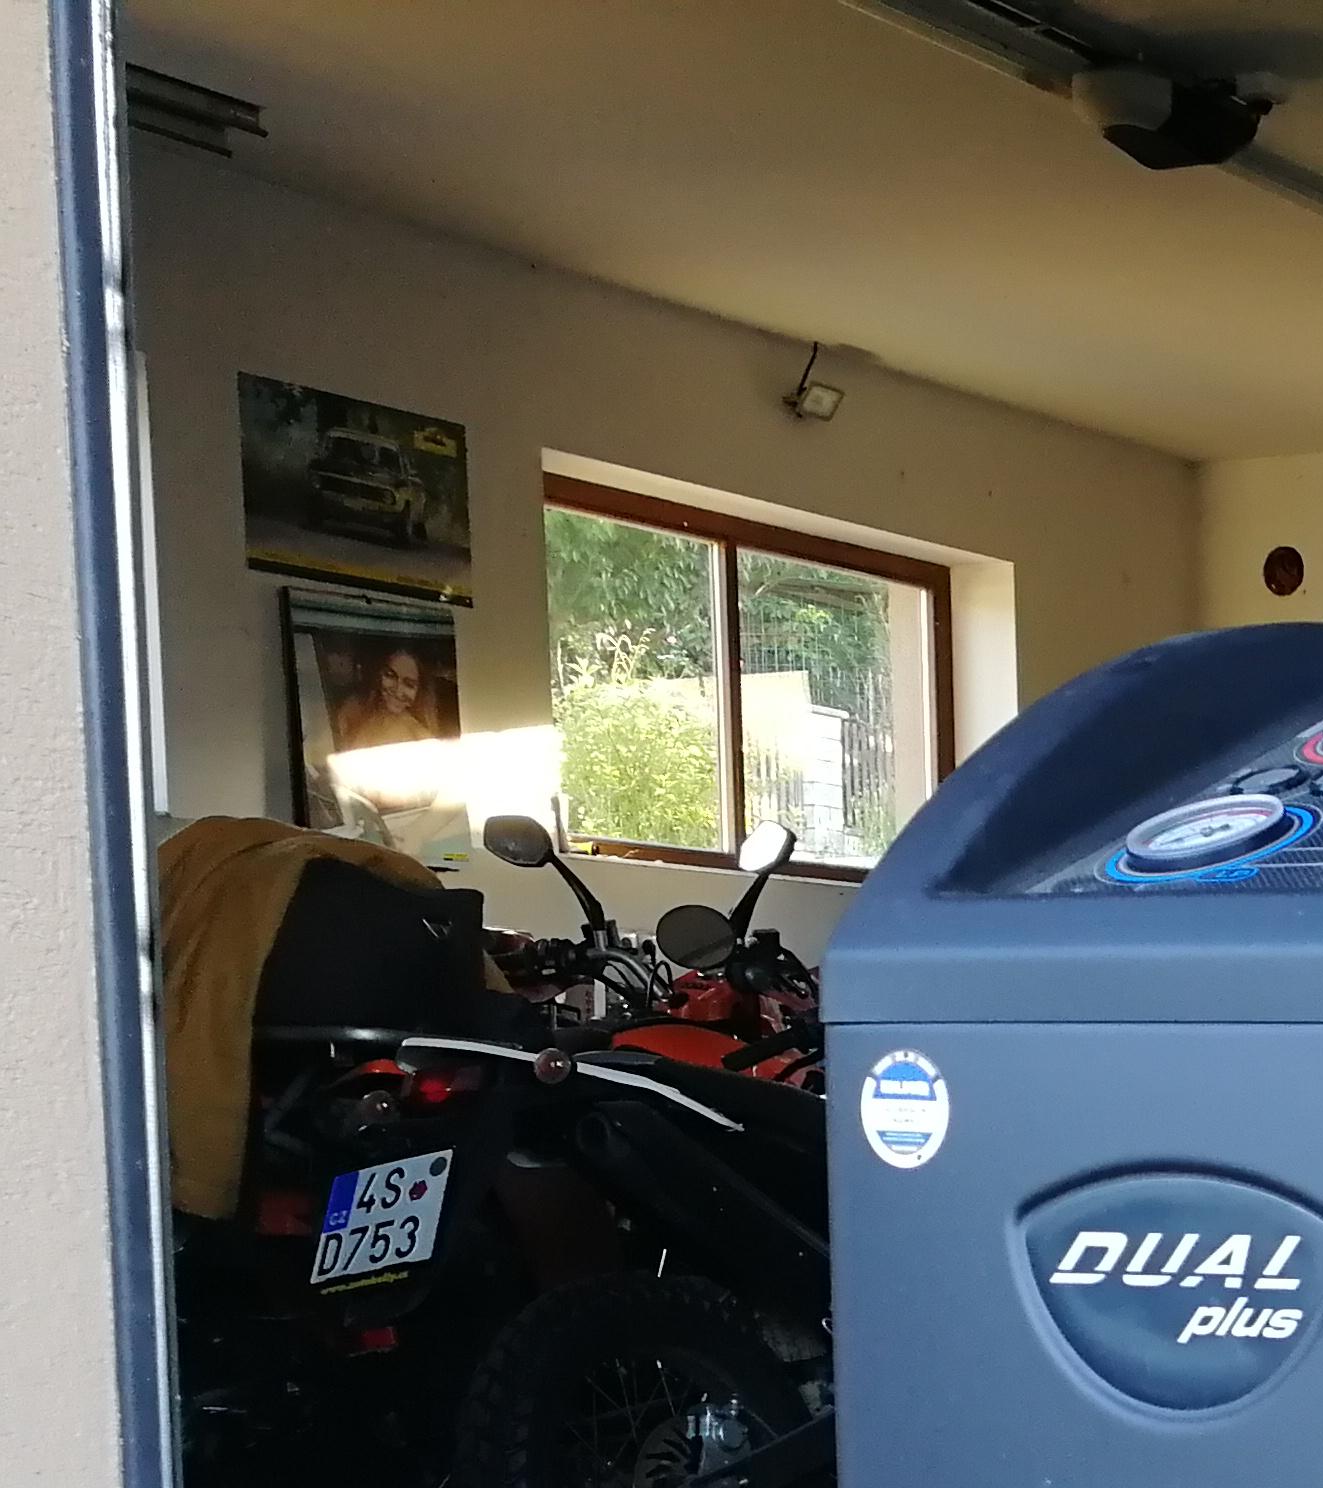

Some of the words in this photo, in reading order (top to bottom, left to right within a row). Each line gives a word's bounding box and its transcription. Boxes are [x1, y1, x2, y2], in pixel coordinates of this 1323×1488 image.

[356, 1166, 406, 1214] 4S
[328, 1210, 349, 1226] CZ
[317, 1215, 420, 1277] D753
[1050, 1231, 1302, 1290] DUAL
[1177, 1296, 1304, 1344] plus
